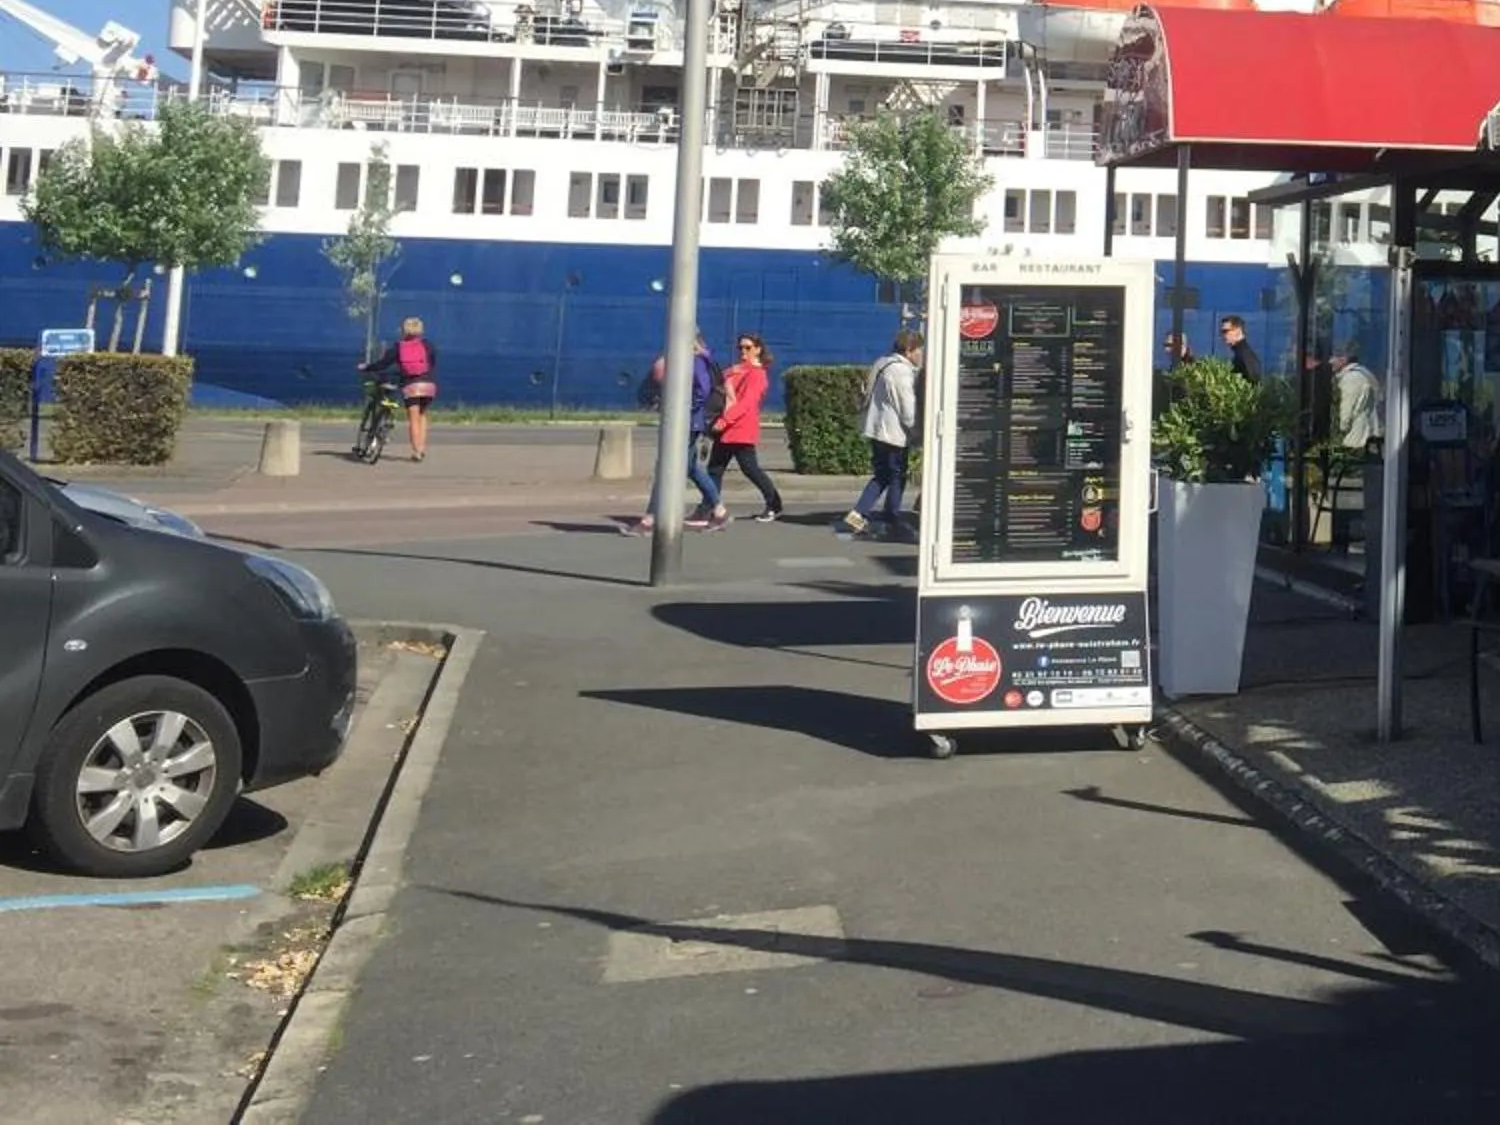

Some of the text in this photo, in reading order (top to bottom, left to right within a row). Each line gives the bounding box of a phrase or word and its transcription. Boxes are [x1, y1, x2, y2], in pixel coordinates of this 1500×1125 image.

[972, 262, 1102, 274] BAR RESTAURANT
[1013, 597, 1126, 631] Bienvenue
